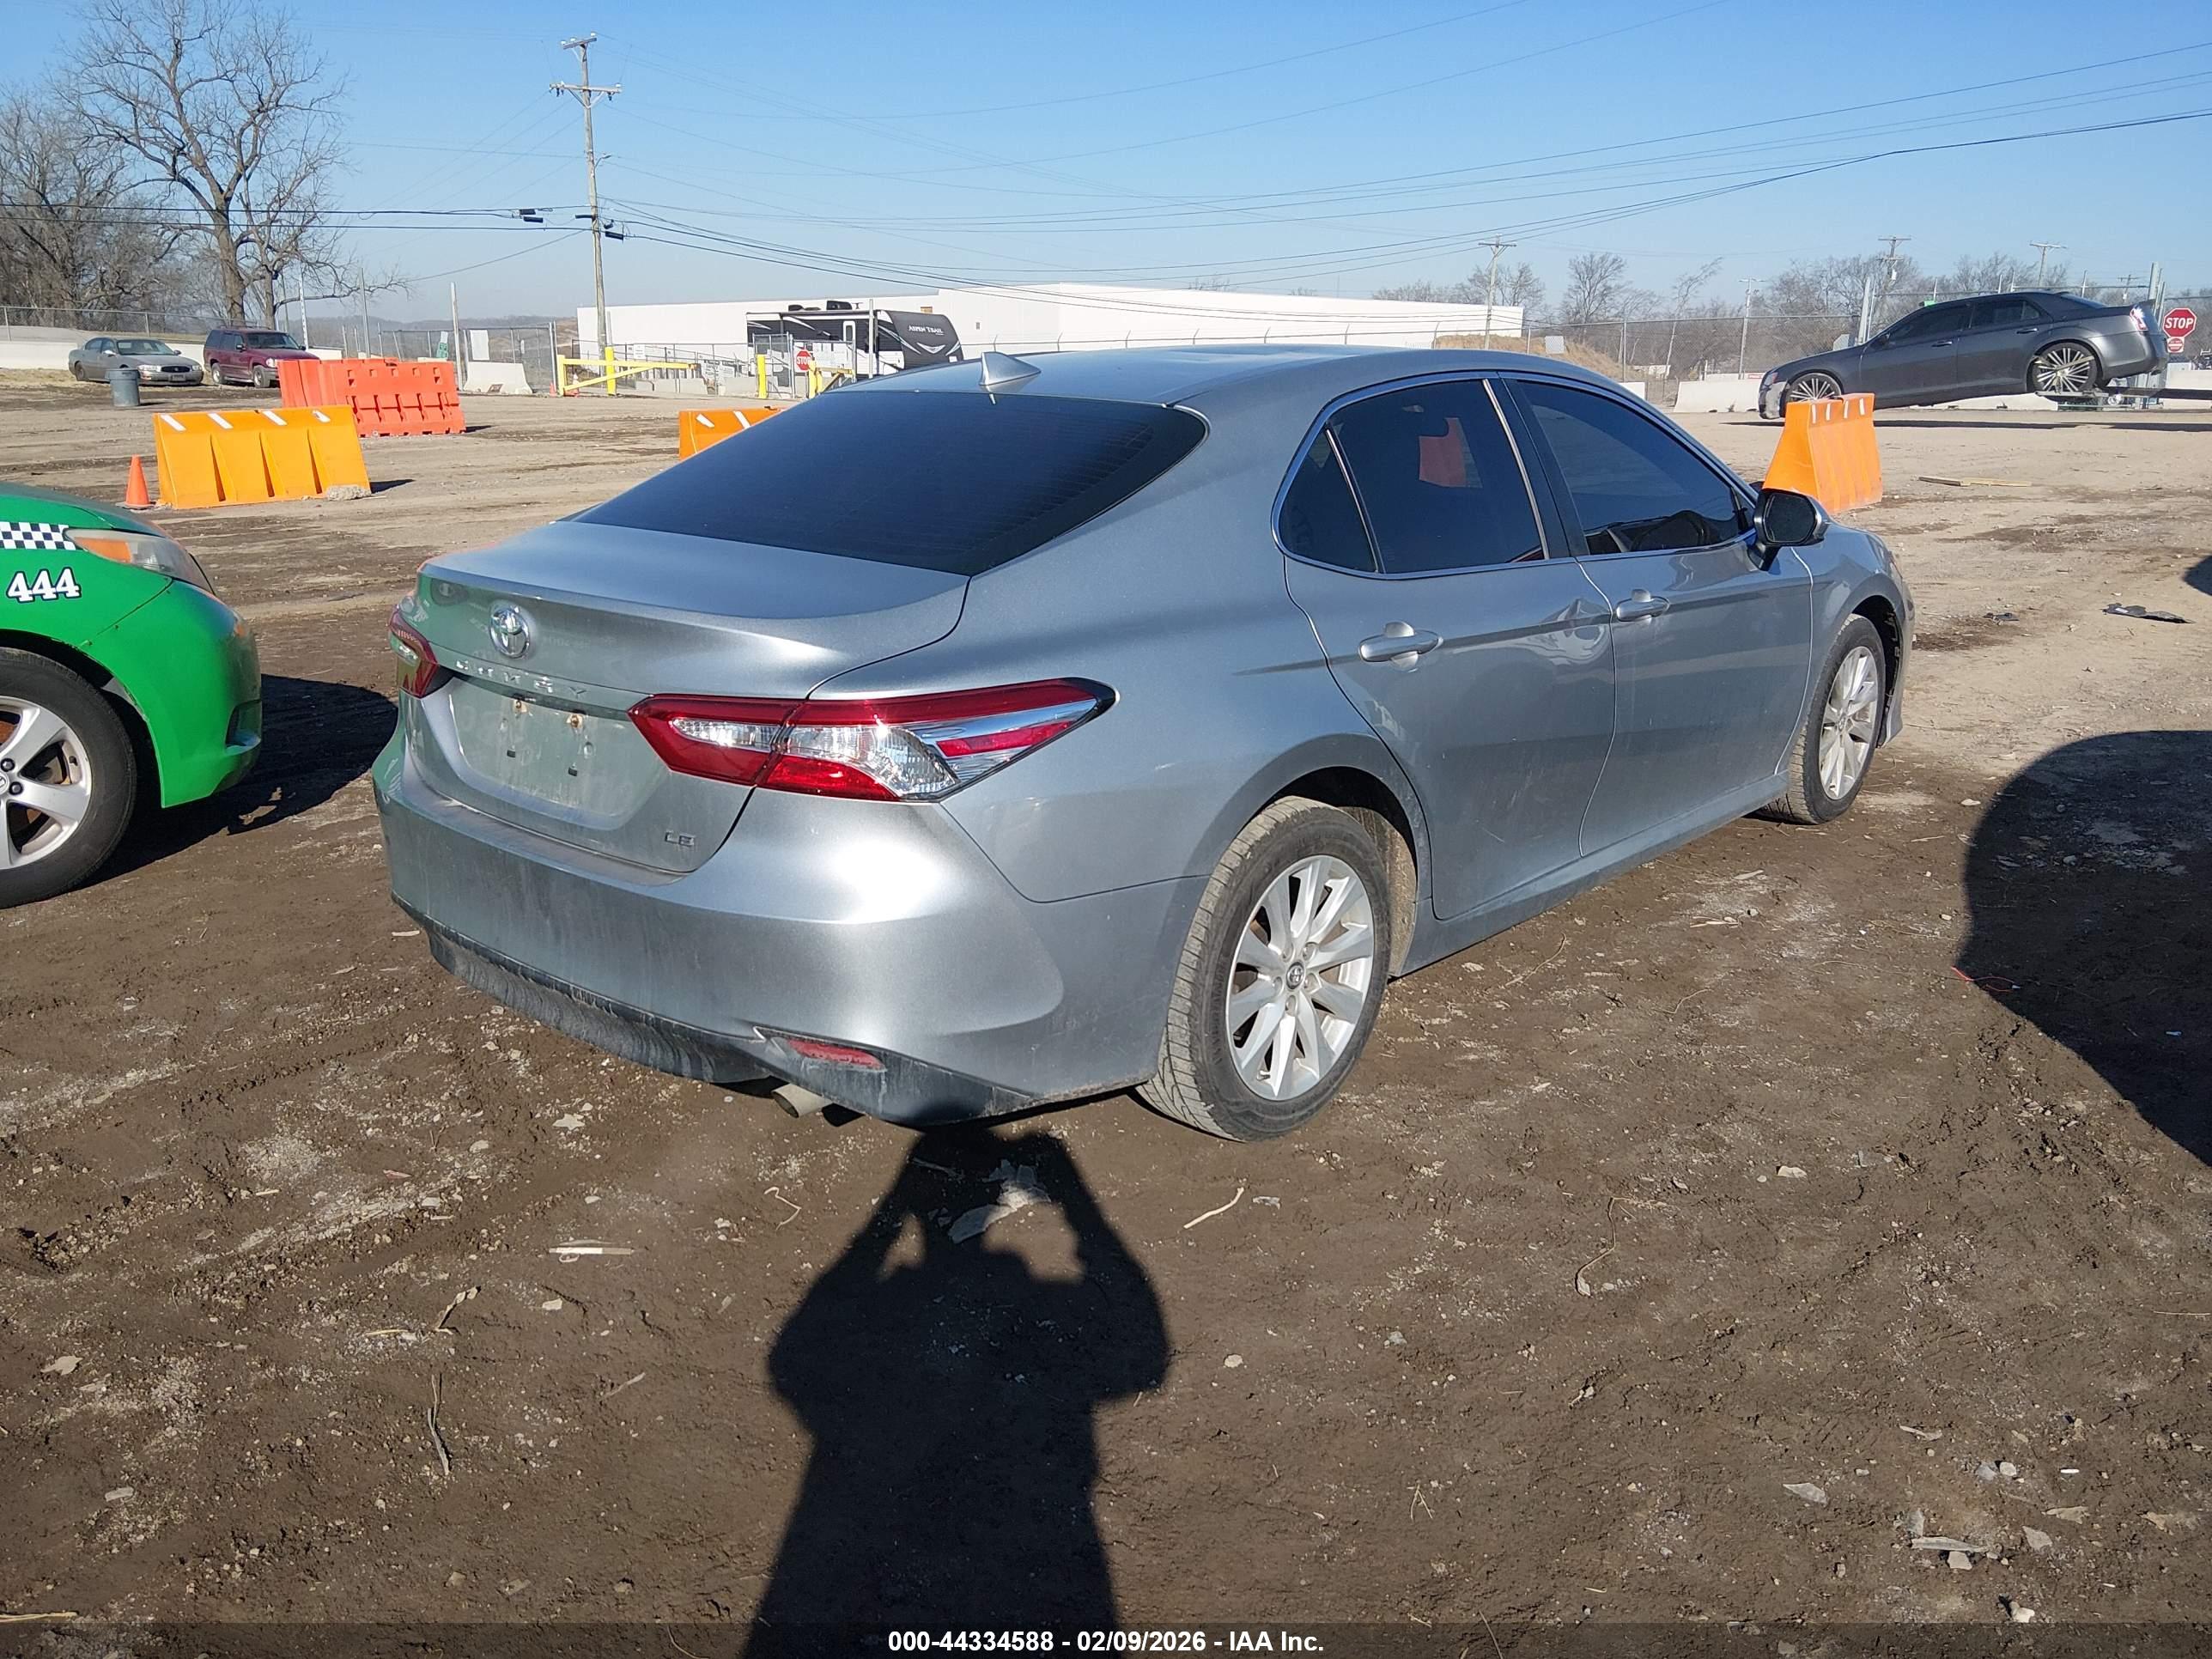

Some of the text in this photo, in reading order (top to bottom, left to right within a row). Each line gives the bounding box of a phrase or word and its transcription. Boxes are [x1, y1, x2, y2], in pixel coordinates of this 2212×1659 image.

[2165, 317, 2194, 329] STOP
[6, 566, 82, 603] 444
[665, 830, 695, 847] LE
